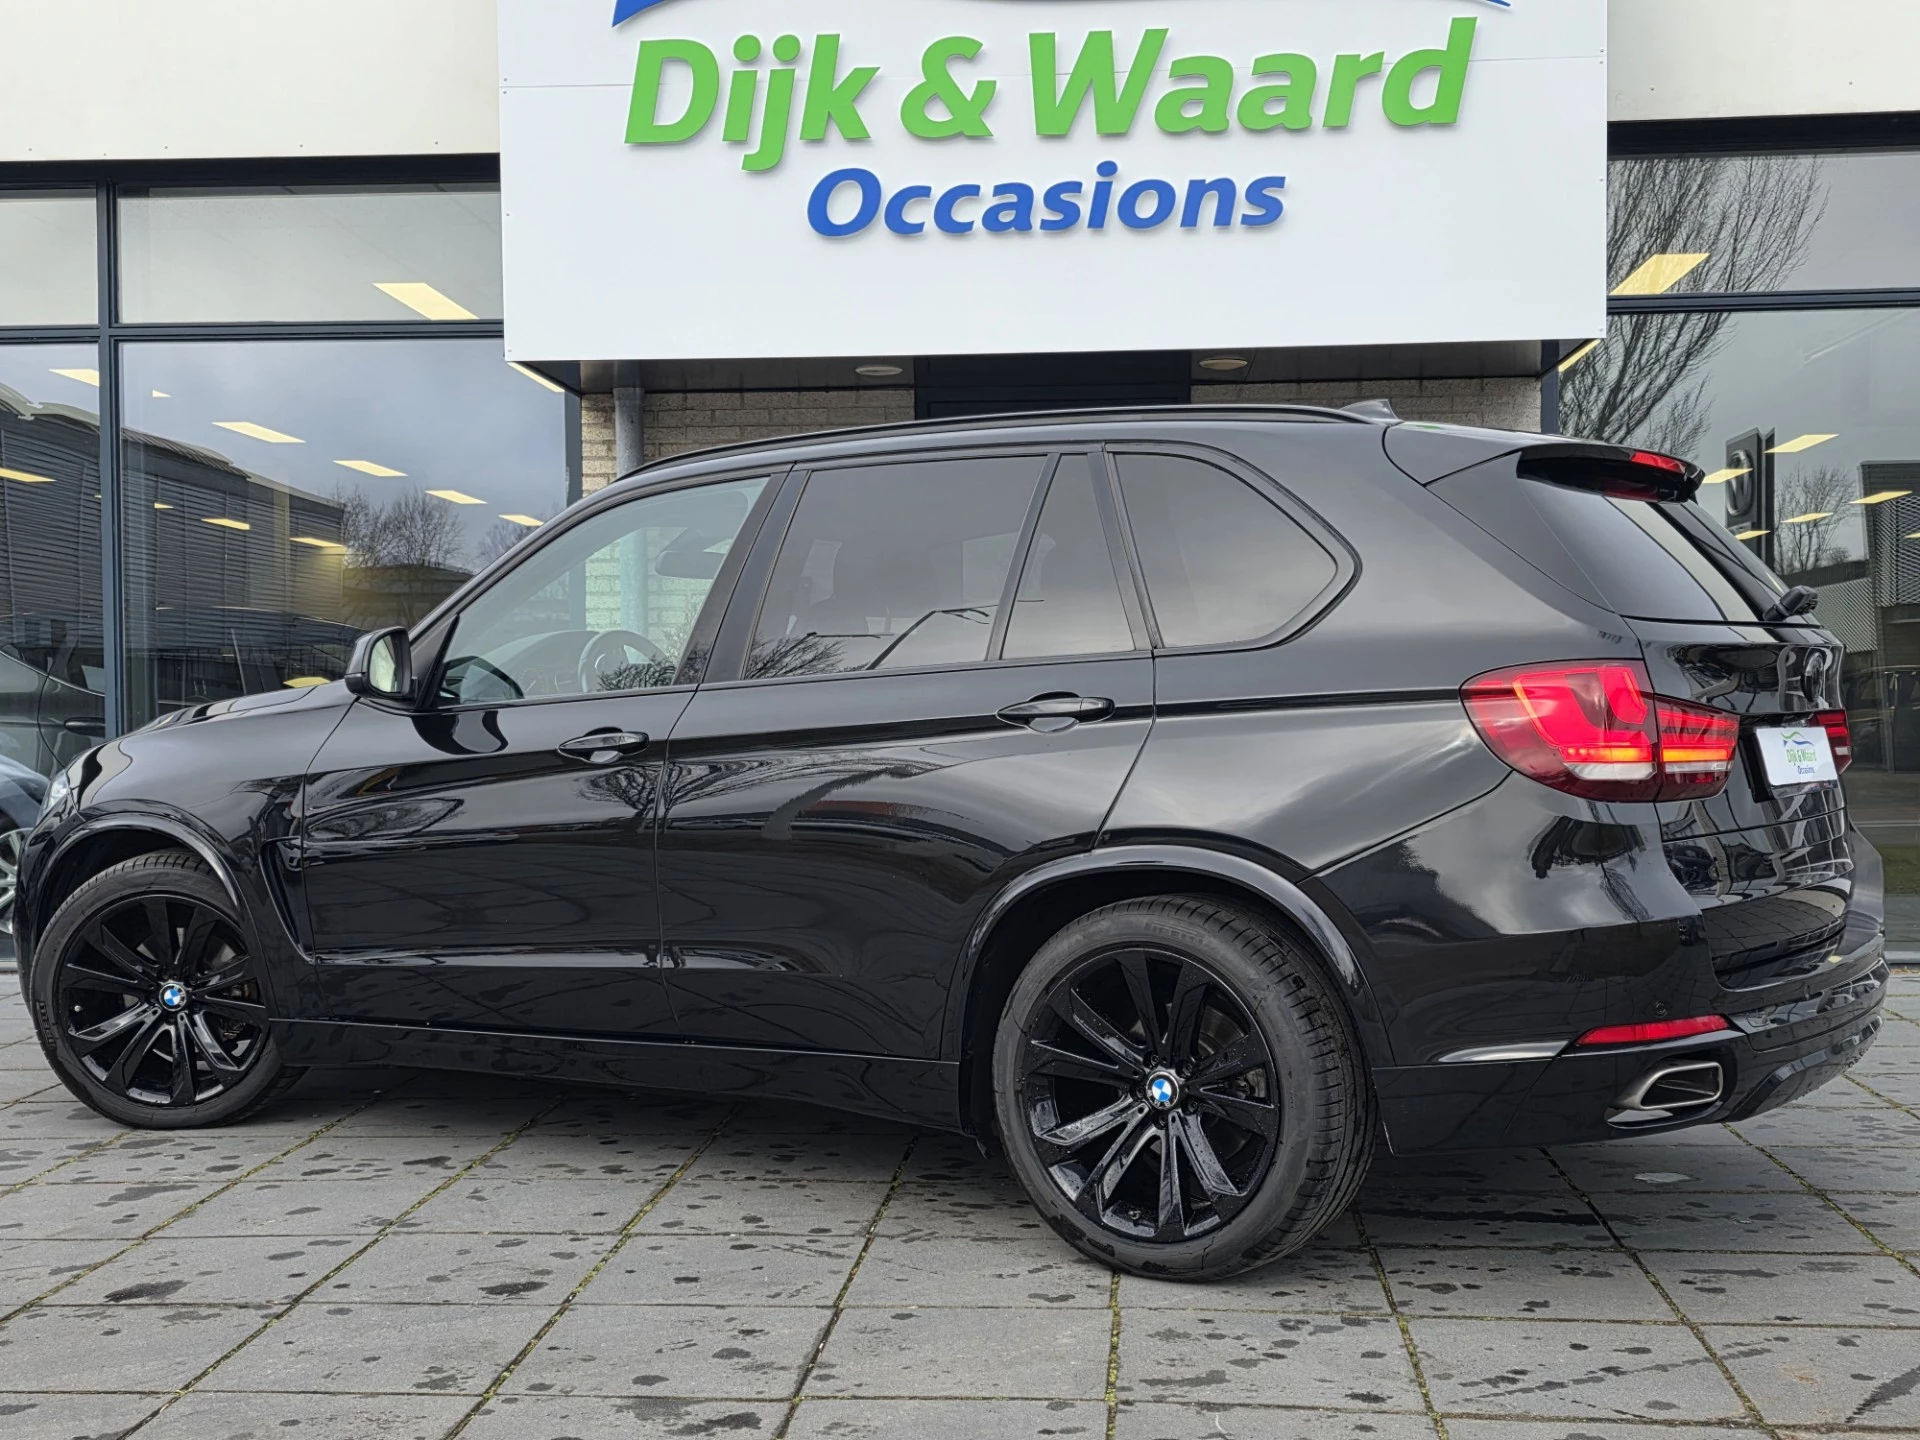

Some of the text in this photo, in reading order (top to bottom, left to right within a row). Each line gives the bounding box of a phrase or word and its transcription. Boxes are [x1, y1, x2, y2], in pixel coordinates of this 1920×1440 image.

[625, 17, 1477, 172] Dijk & Waard
[806, 160, 1287, 238] Occasions
